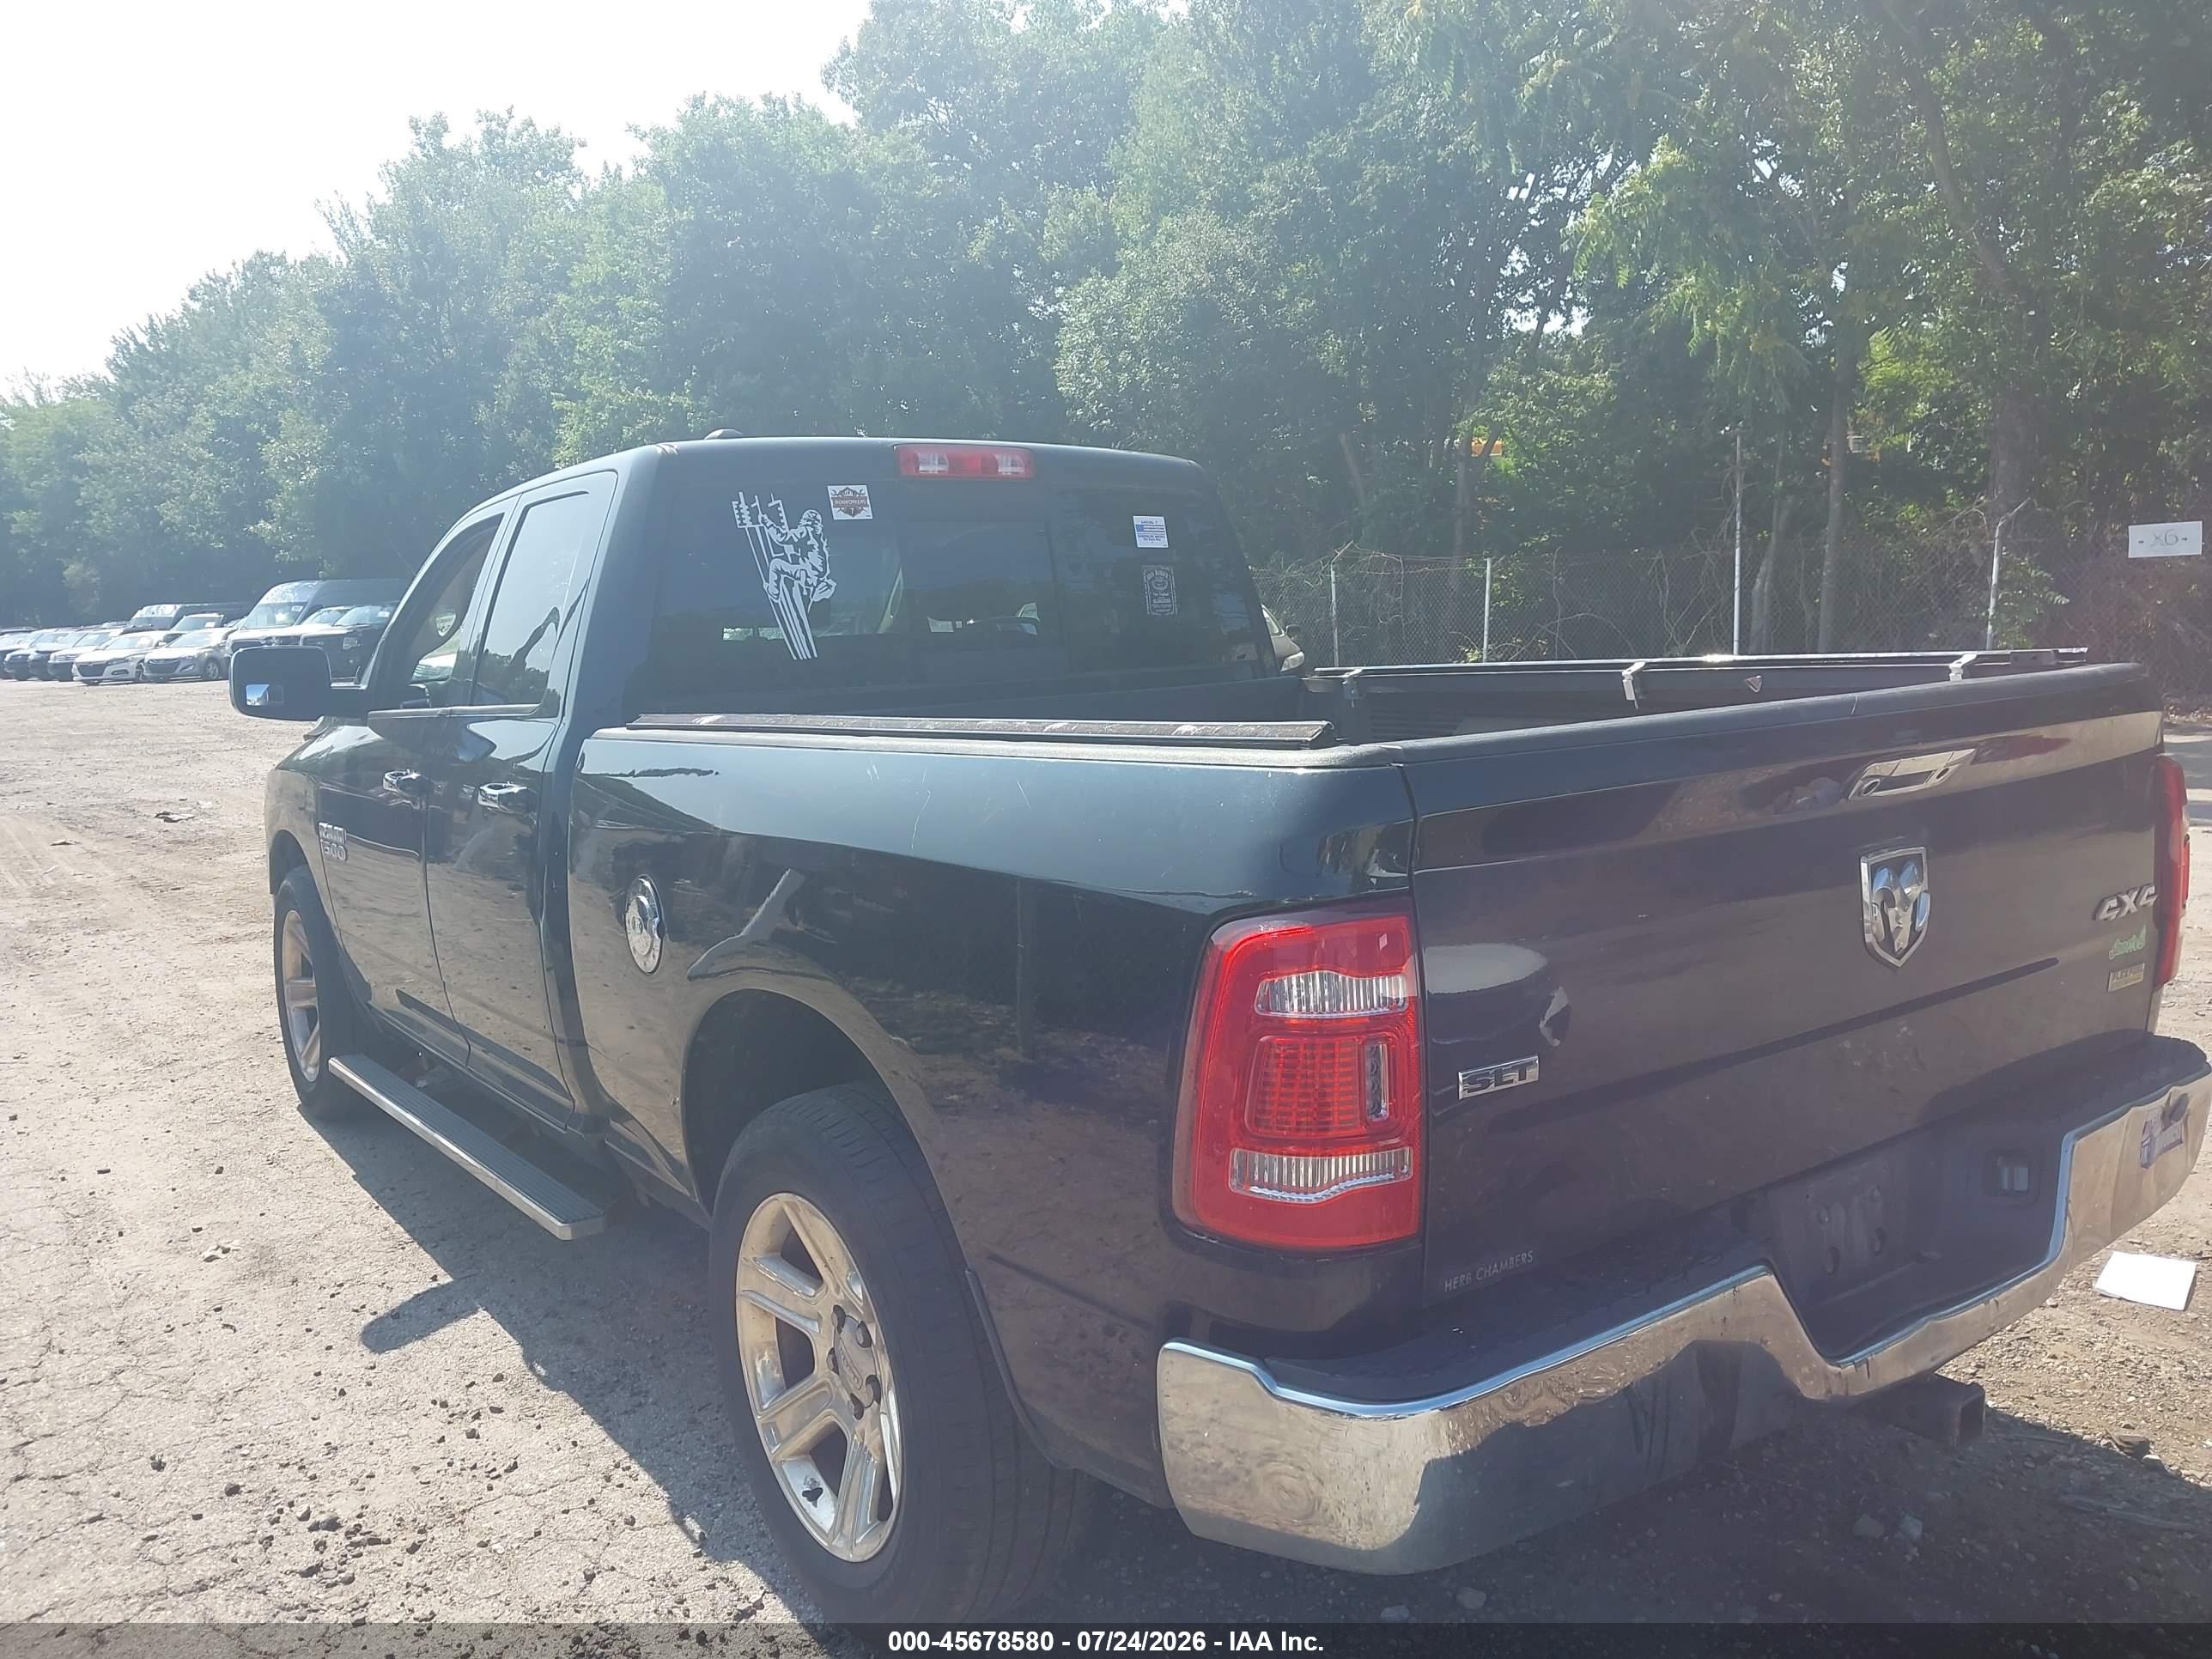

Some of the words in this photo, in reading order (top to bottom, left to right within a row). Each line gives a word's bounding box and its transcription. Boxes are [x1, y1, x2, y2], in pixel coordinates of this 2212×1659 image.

[1462, 1060, 1534, 1094] SLT
[1444, 1272, 1472, 1292] HERB
[1475, 1250, 1533, 1280] CHAMBERS
